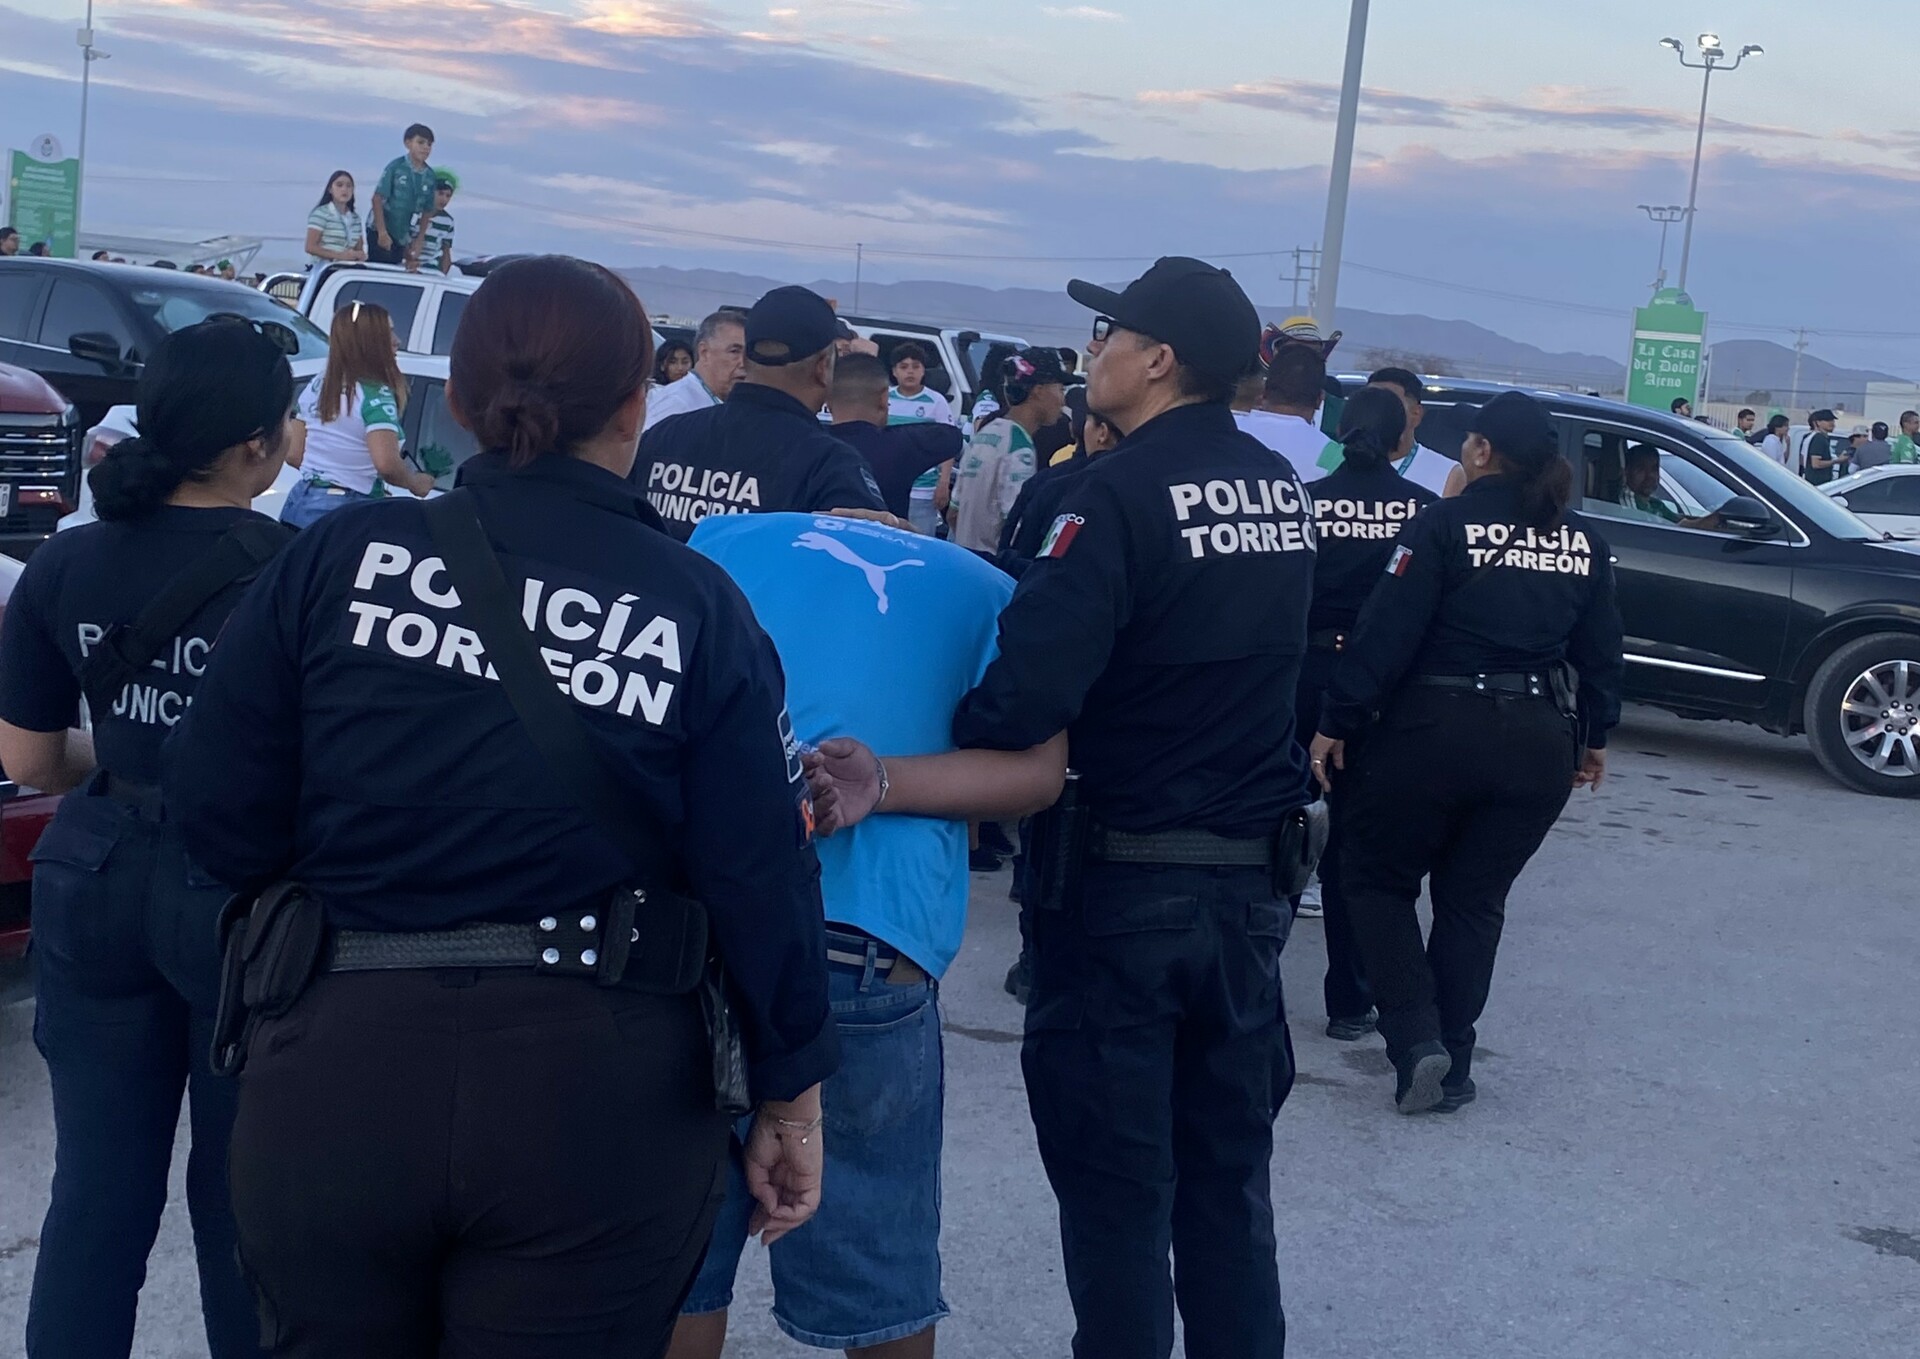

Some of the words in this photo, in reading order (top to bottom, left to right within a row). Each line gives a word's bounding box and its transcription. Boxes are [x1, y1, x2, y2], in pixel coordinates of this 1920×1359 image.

[1633, 358, 1652, 371] del
[1659, 359, 1697, 374] Dolor
[1638, 342, 1655, 356] La
[1662, 345, 1696, 359] Casa
[1644, 372, 1682, 387] Ajeno
[648, 462, 760, 507] POLICÍA
[646, 492, 750, 525] MUNICIP
[1314, 498, 1428, 520] POLICÍ
[1181, 514, 1317, 558] TORREÓ
[353, 541, 682, 674] POICÍA
[78, 623, 210, 676] PIC
[348, 600, 675, 726] TOREÓN
